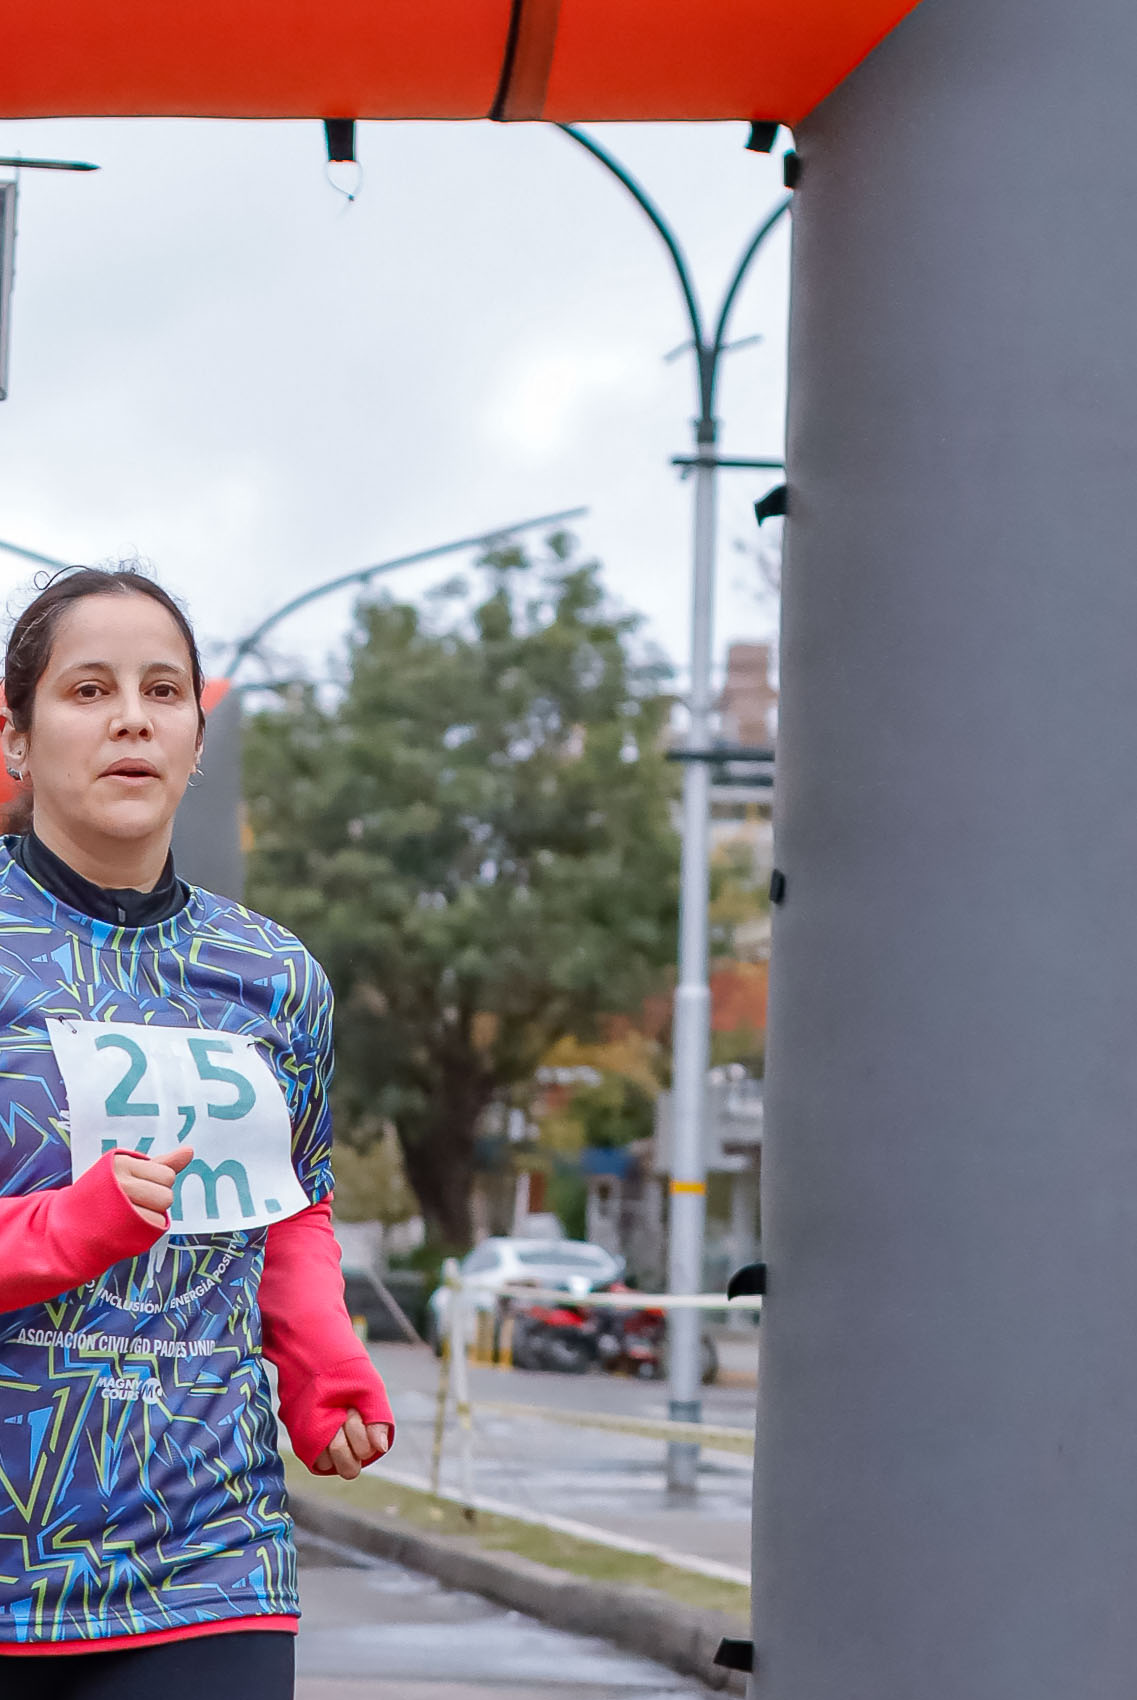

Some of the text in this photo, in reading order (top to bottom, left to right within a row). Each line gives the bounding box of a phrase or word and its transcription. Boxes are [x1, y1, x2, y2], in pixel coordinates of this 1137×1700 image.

[94, 1032, 257, 1143] 2,5
[101, 1136, 283, 1221] m.
[170, 1278, 216, 1309] ENERGÍA
[17, 1327, 96, 1352] ASOCIACIÓN
[98, 1335, 129, 1354] CIVIL
[95, 1376, 143, 1390] MAGNY
